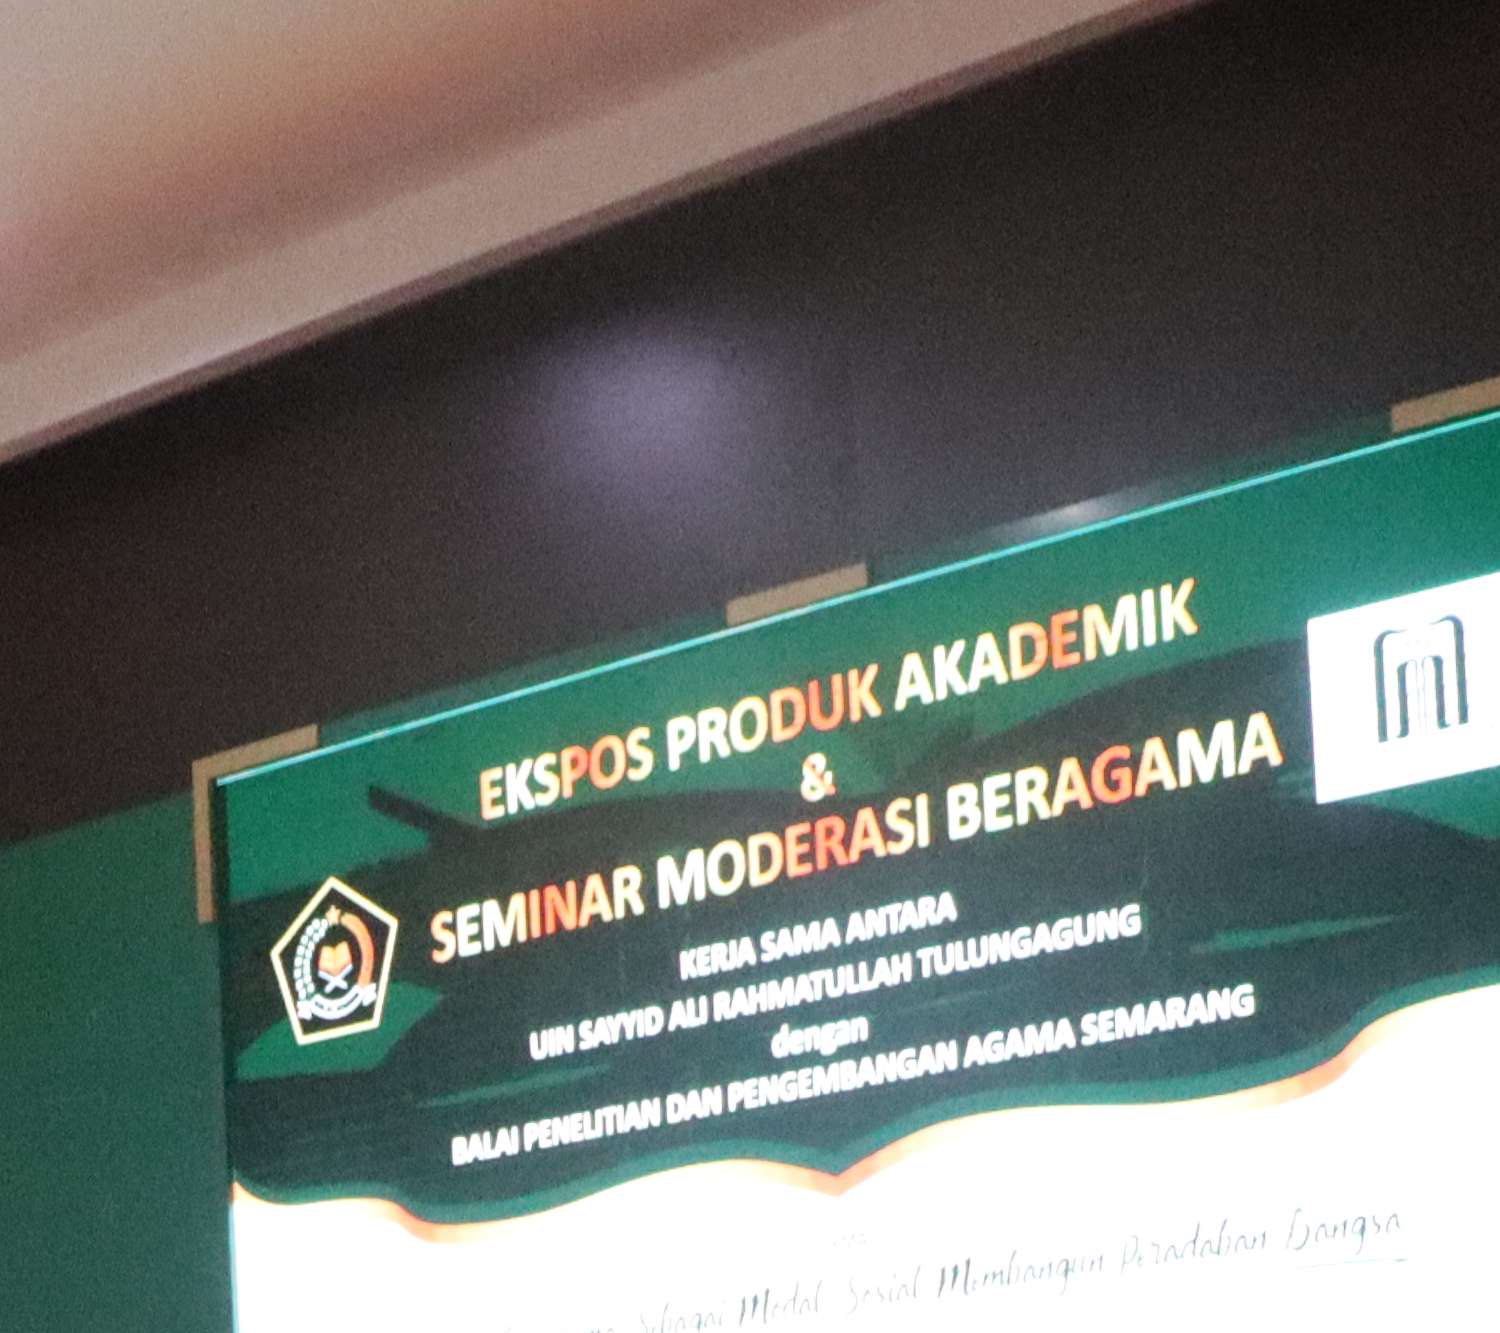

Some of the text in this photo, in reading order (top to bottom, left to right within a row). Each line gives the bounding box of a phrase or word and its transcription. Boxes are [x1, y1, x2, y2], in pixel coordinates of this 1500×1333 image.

[479, 577, 1199, 821] EKSPOS PRODUK AKADEMIK
[430, 711, 1284, 965] SEMINAR MODERASI BERAGAMA
[799, 752, 837, 803] &
[529, 904, 1142, 1061] UIN SAYYID ALI RAHMATULLAH TULUNGAGUNG
[678, 891, 958, 981] KERJA SAMA ANTARA
[451, 983, 1256, 1167] BALAI PENELITIAN DAN PENGEMBANGAN AGAMA SEMARANG
[769, 1014, 870, 1059] dengan
[937, 1249, 1104, 1299] Membangun
[1120, 1218, 1267, 1276] Peradaban
[1285, 1207, 1402, 1256] Bangsa
